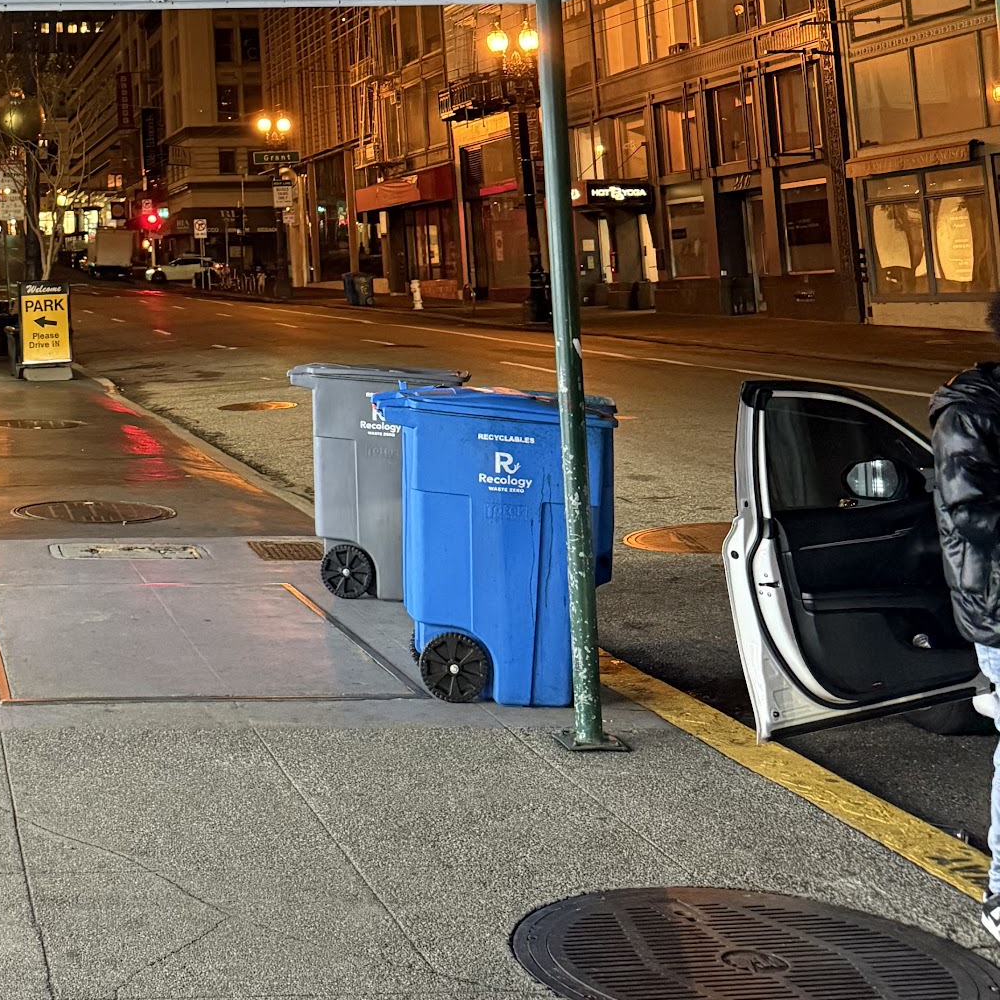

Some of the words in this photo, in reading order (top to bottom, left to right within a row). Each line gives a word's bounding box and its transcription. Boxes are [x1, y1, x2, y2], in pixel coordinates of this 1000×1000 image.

[591, 188, 609, 197] HOT
[26, 284, 62, 293] Welcome
[25, 298, 65, 312] PARK
[32, 332, 60, 340] Please
[29, 341, 50, 349] Drive
[360, 421, 401, 433] Recology
[478, 433, 535, 444] RECYCLABLES
[478, 473, 533, 489] Recology
